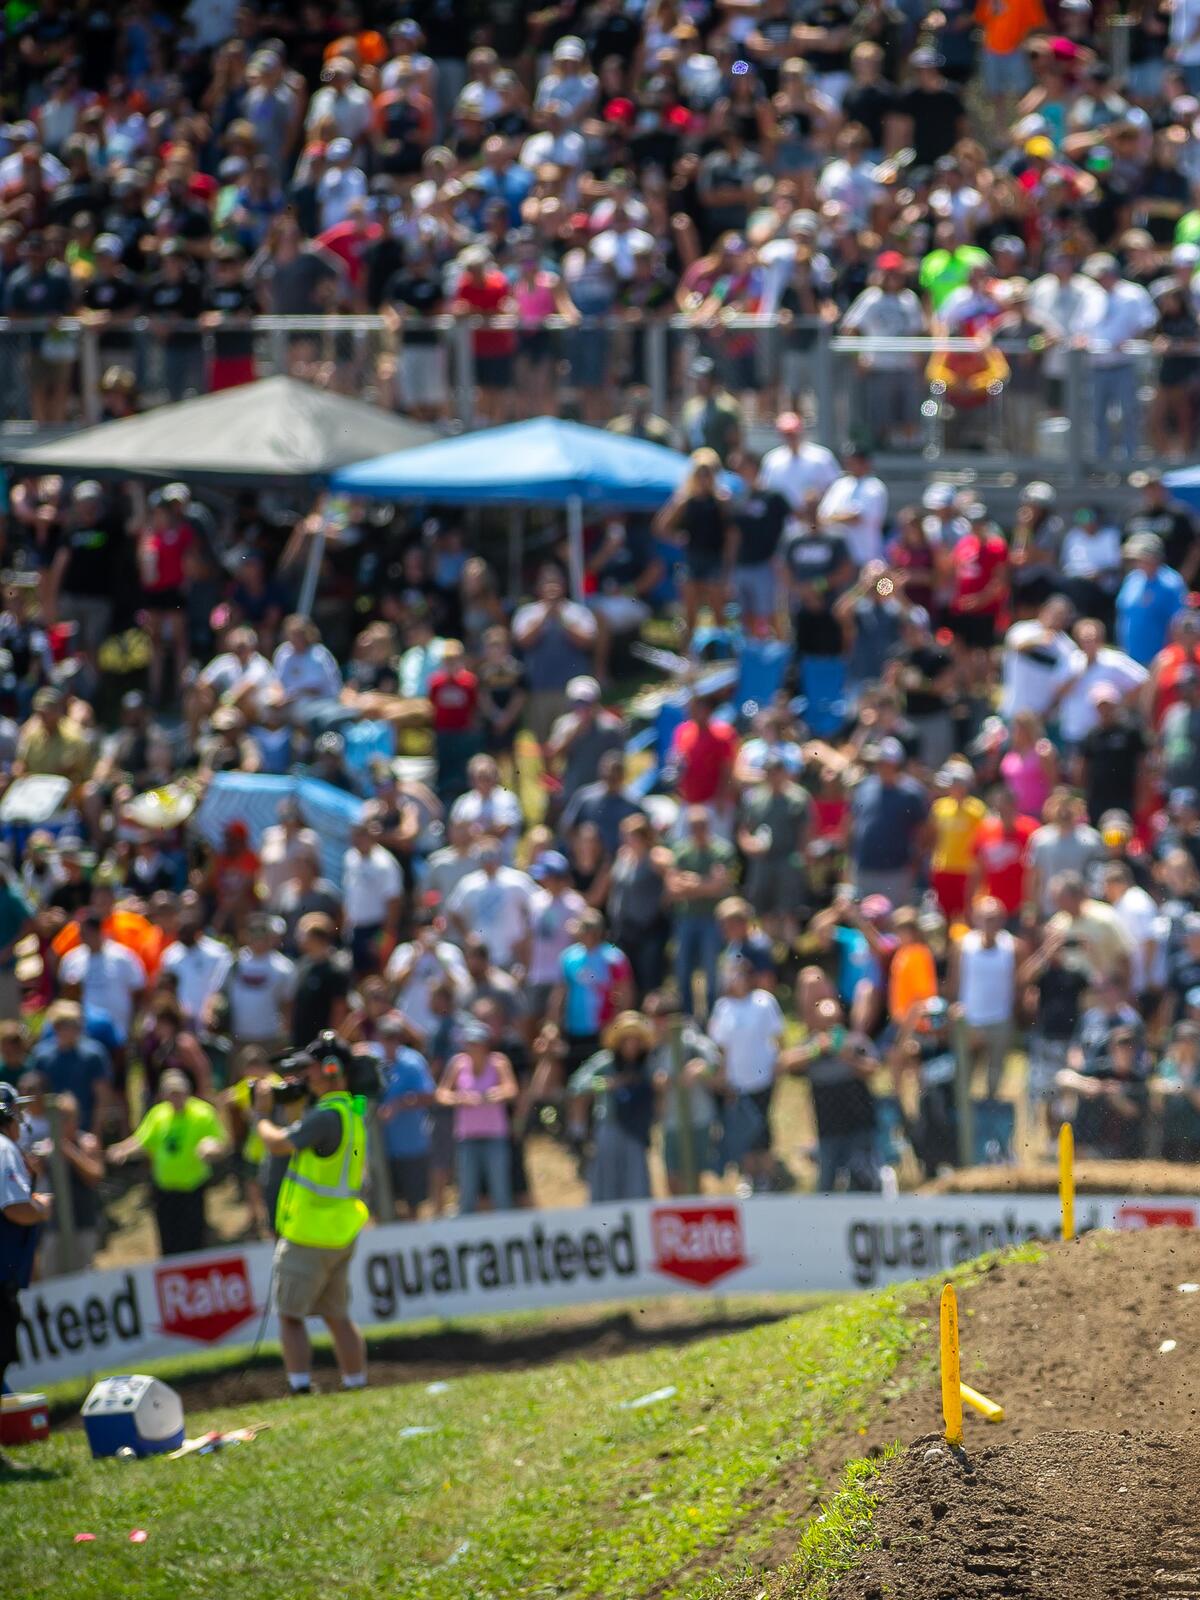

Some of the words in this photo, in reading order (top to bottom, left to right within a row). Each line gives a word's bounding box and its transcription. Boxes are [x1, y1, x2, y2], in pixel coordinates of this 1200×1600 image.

[366, 1209, 638, 1321] guaranteed
[659, 1213, 738, 1261] Rate
[16, 1271, 141, 1367] nteed
[161, 1271, 250, 1324] Rate
